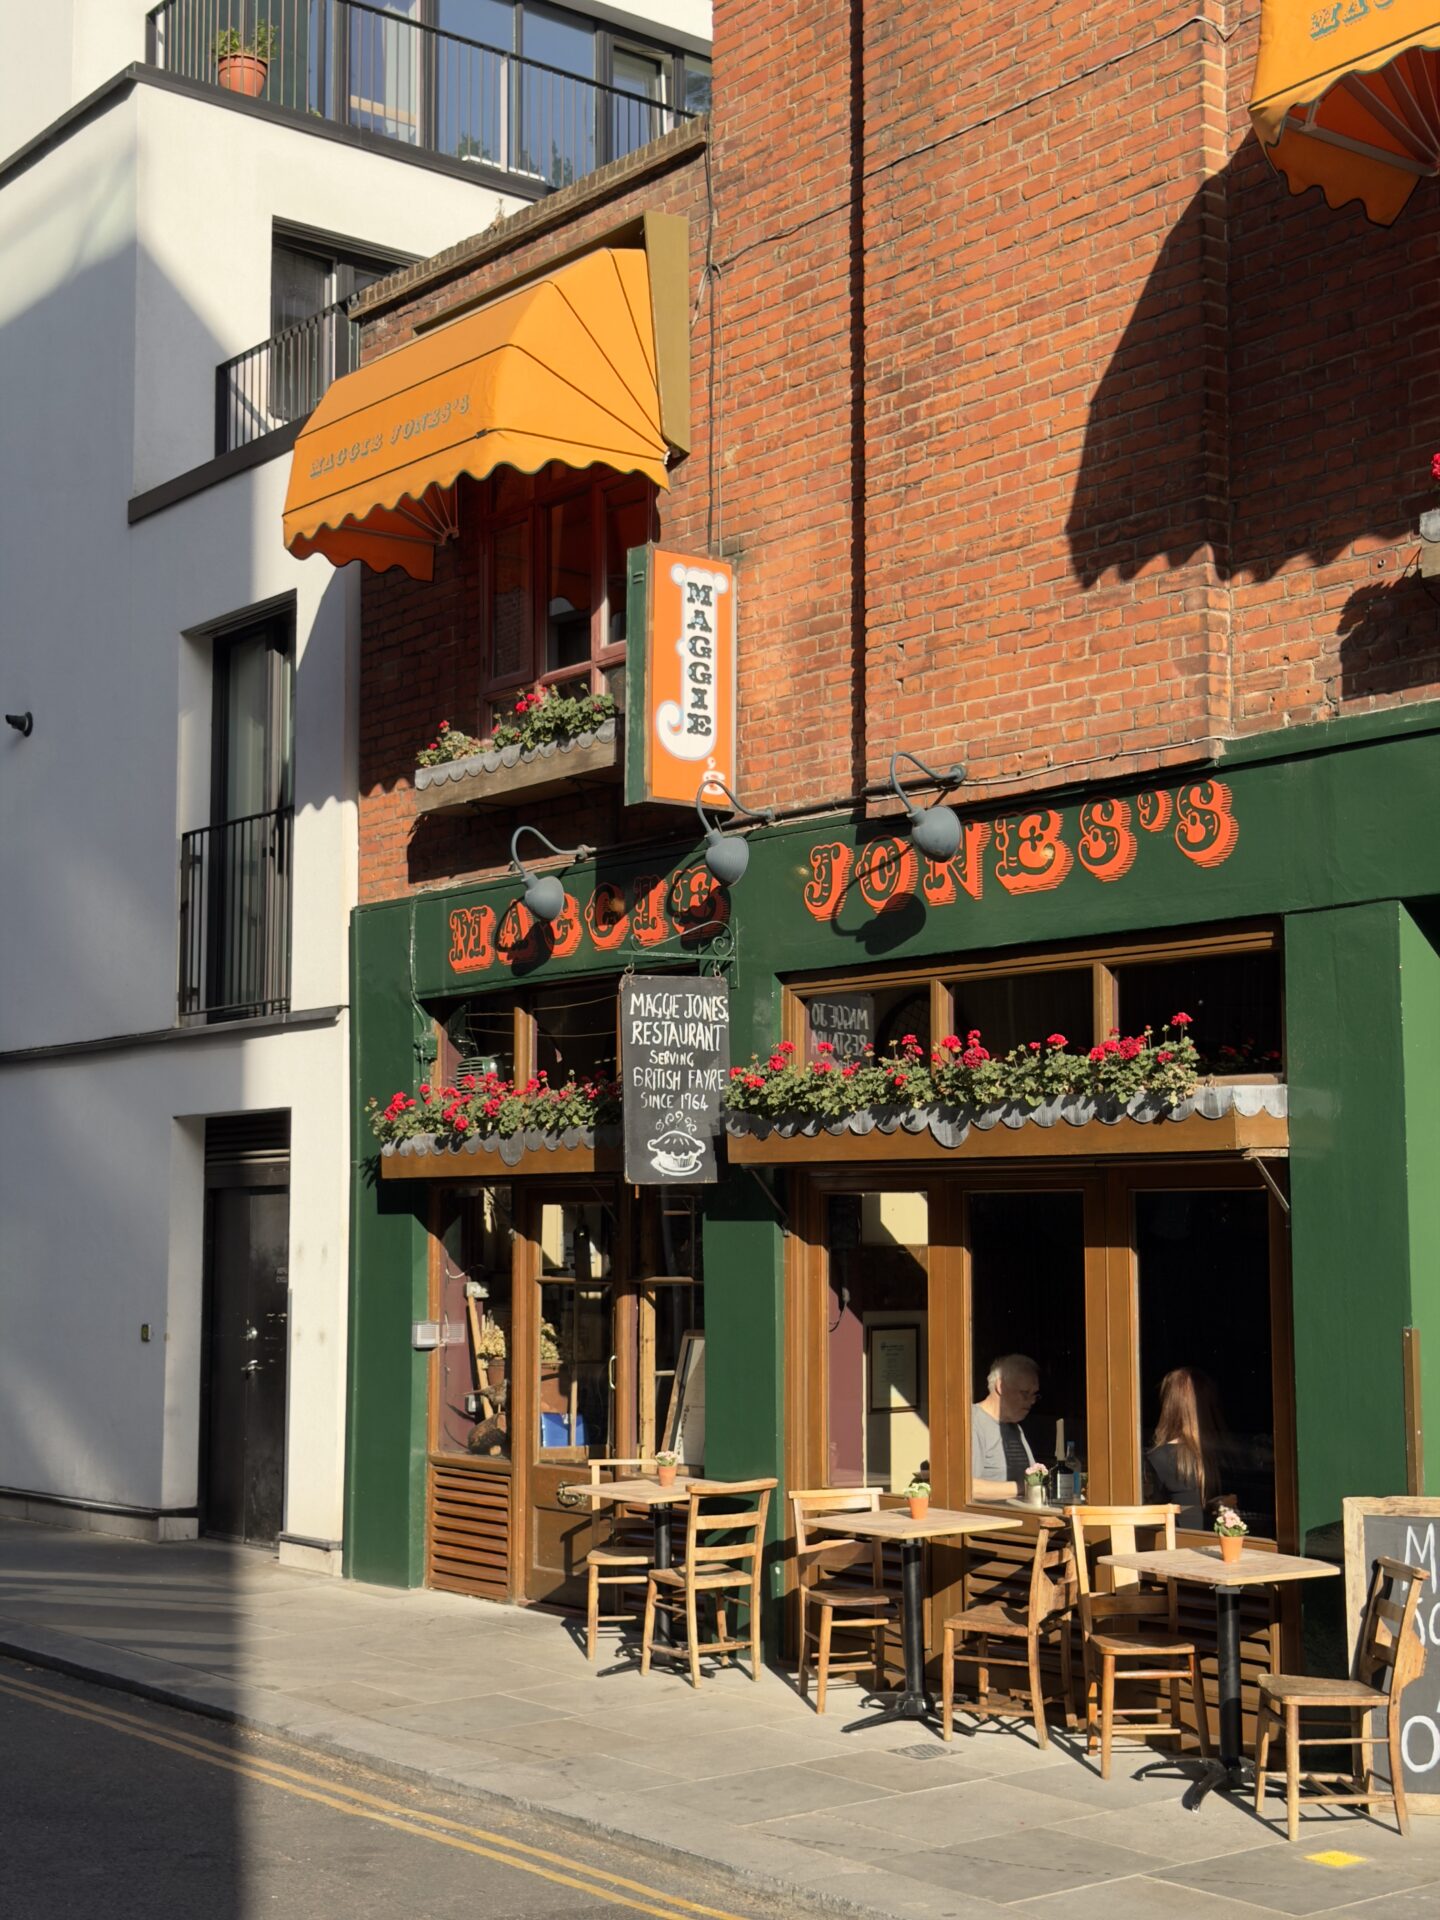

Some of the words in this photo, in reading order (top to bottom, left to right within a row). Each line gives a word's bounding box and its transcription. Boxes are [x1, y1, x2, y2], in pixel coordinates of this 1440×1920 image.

[1310, 0, 1394, 40] MA
[309, 433, 384, 478] MAGGIE
[390, 394, 470, 445] JONES'S
[686, 581, 713, 738] MAGGIE
[803, 778, 1239, 922] JONES'S
[629, 993, 683, 1020] MAGGIE
[630, 1020, 727, 1052] RESTAURANT
[649, 1049, 694, 1067] SERVING
[633, 1066, 681, 1091] BRITISH
[688, 1068, 726, 1091] FAYRE
[640, 1092, 674, 1109] SINCE
[680, 1092, 709, 1111] 1964
